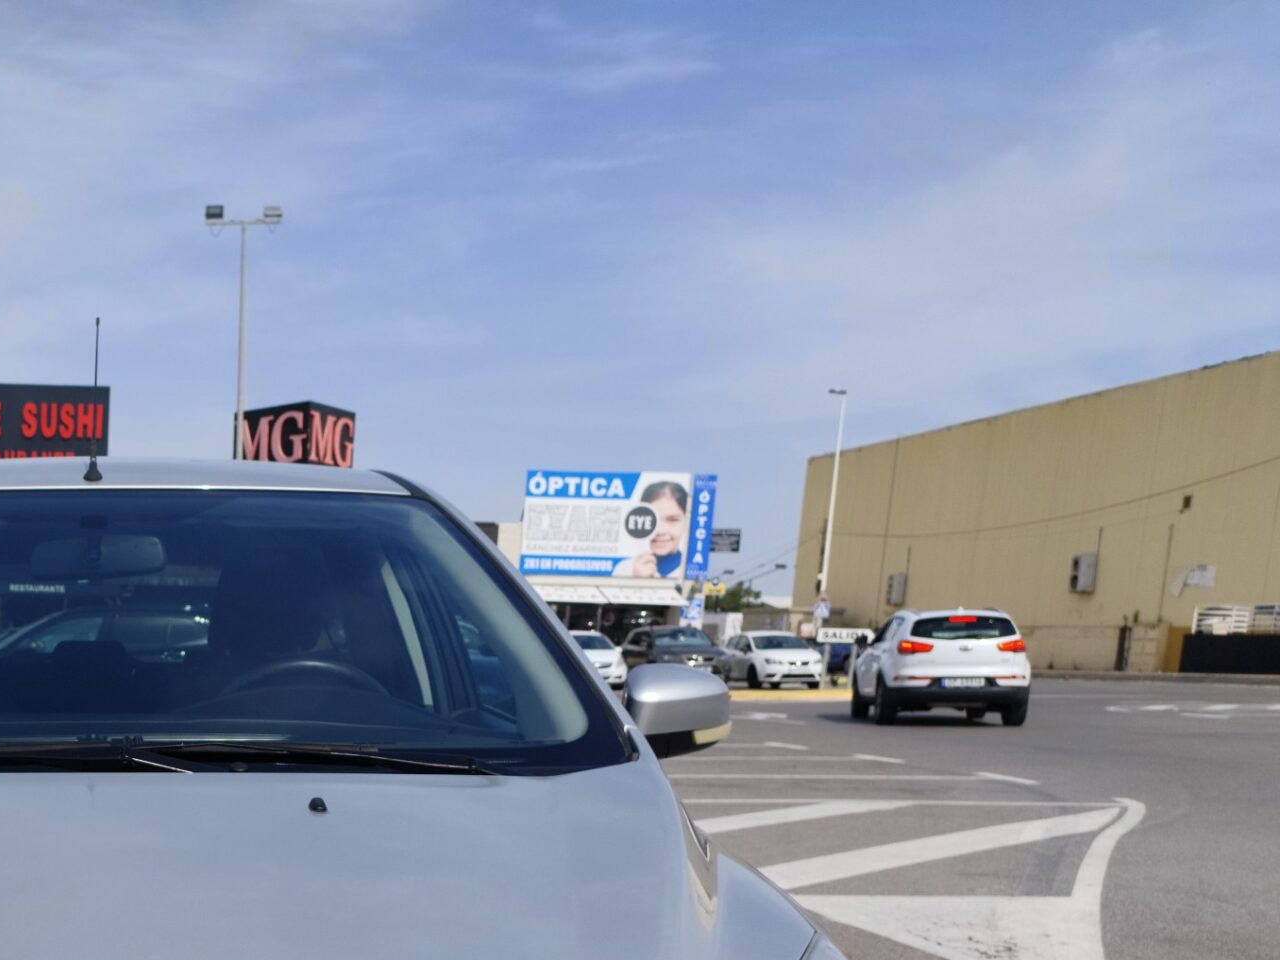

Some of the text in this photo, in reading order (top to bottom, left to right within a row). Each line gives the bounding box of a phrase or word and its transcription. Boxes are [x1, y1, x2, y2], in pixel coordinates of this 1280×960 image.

[22, 402, 104, 439] SUSHI
[243, 410, 307, 462] MG
[308, 409, 354, 468] MG
[528, 472, 625, 498] ÓPTICA
[628, 515, 652, 530] EYE
